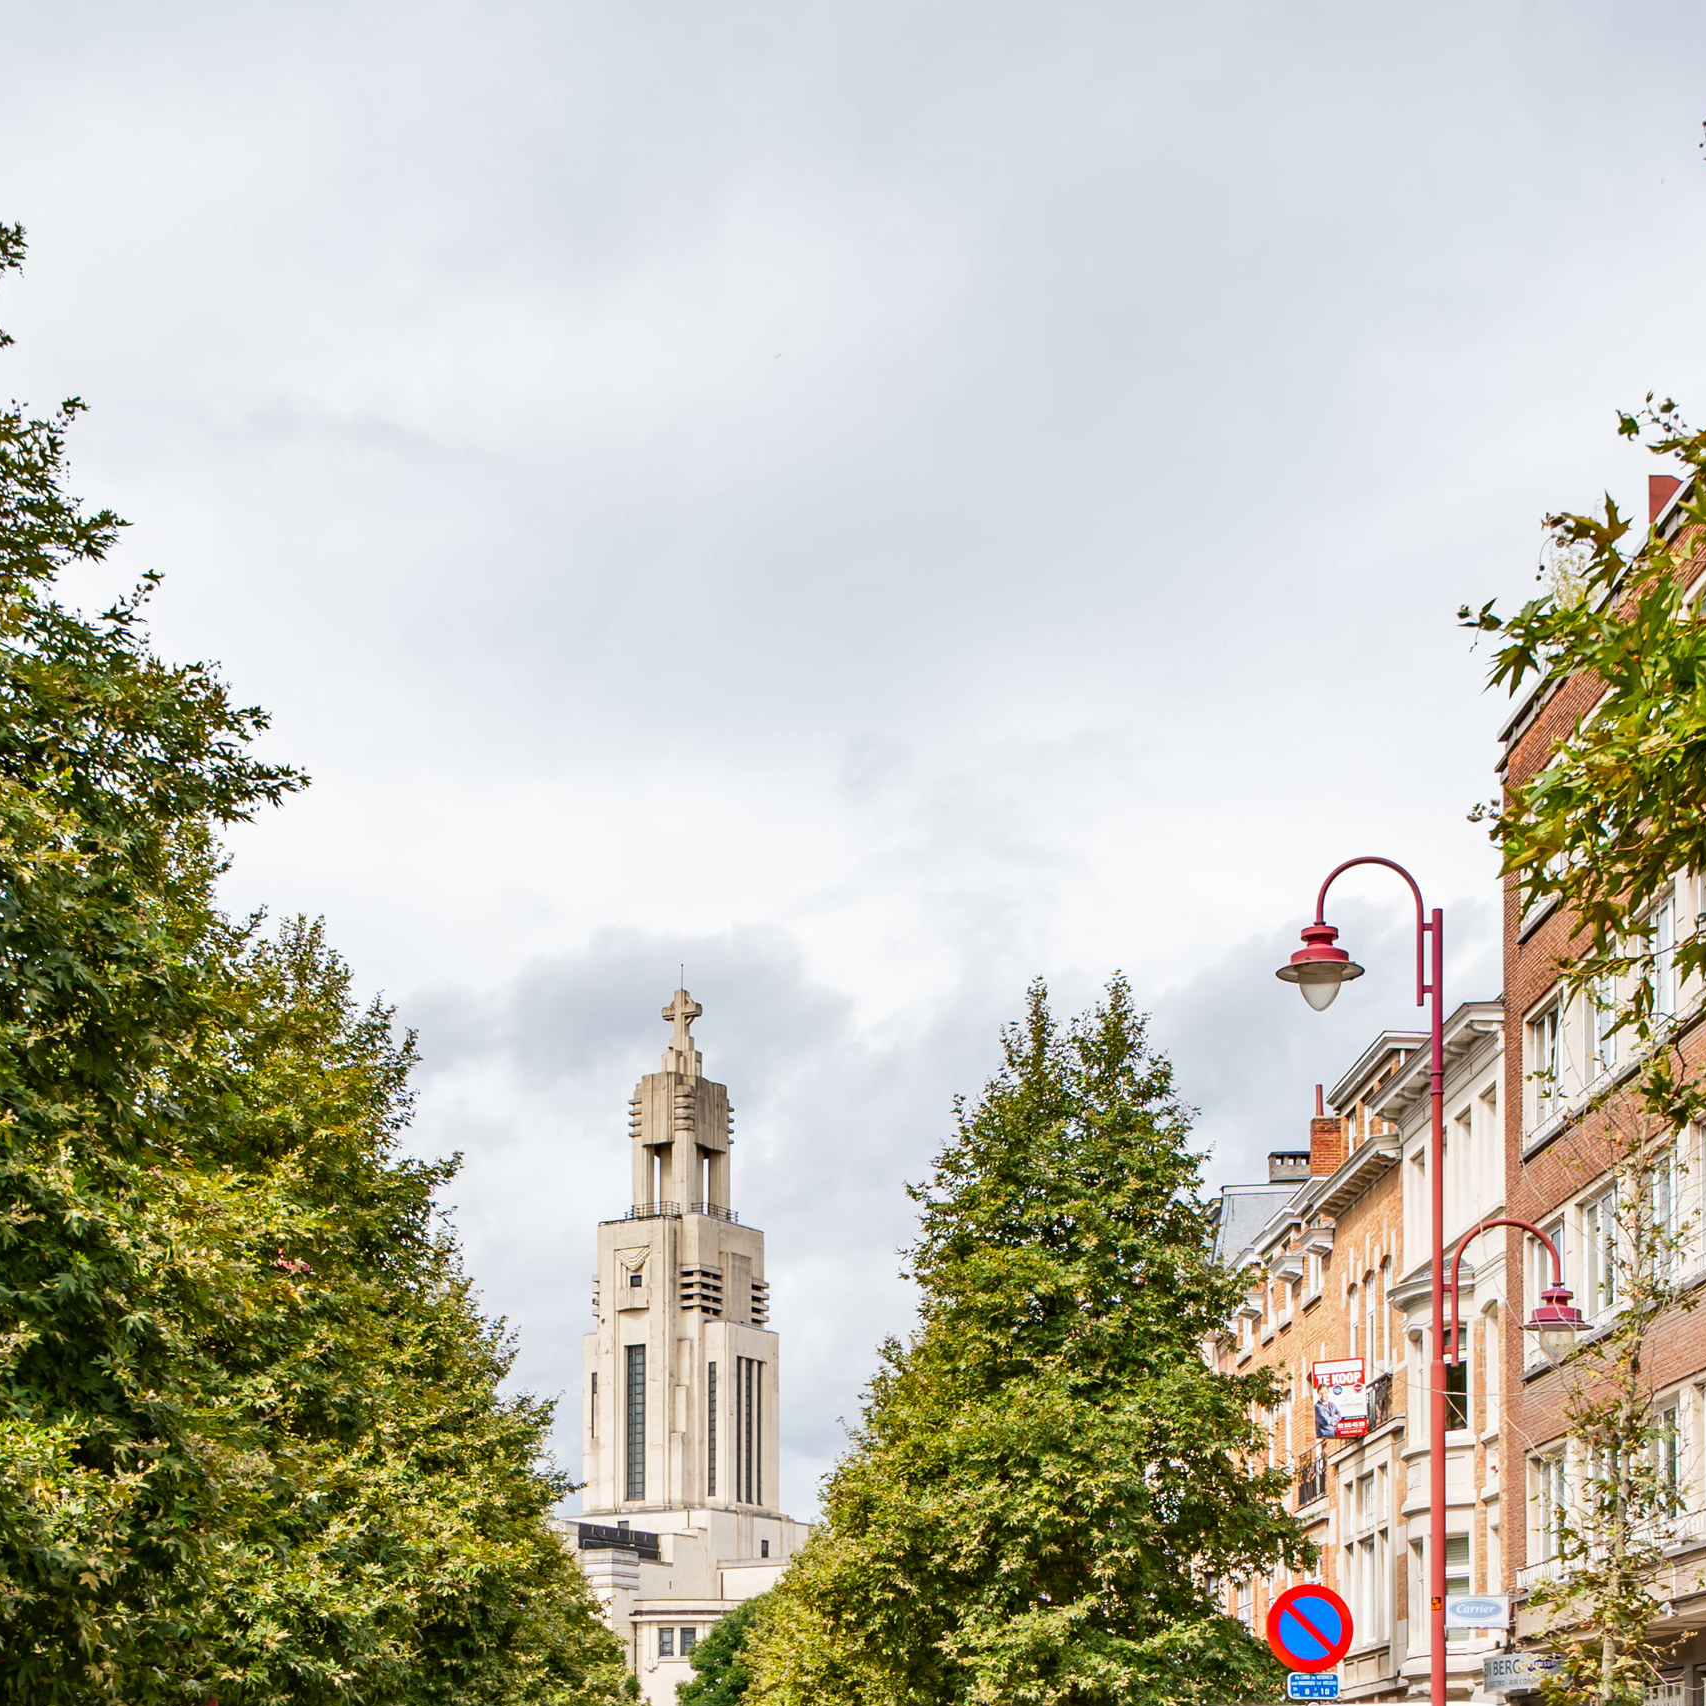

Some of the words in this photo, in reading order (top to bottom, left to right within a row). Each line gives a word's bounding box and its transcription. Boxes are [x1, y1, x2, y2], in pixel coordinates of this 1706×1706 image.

[1316, 1374, 1330, 1386] TE
[1331, 1372, 1361, 1385] KOOP
[1456, 1604, 1495, 1614] Carrier
